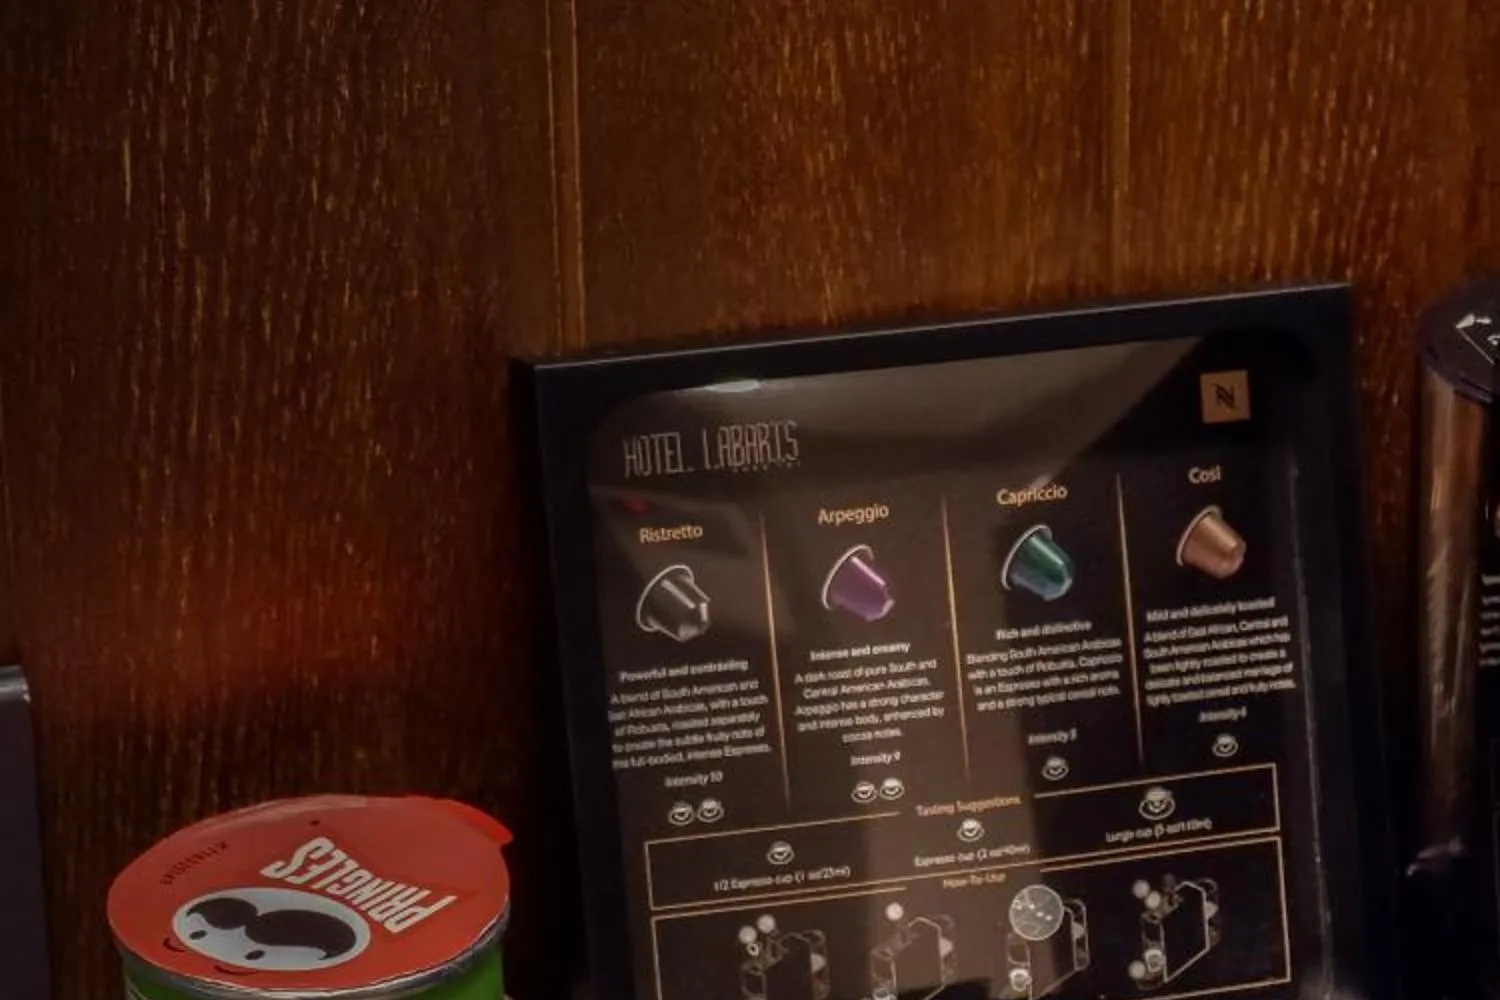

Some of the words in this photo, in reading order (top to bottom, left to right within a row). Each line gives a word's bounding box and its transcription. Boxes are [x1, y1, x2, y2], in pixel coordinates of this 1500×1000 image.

[623, 431, 695, 478] HOTEL
[703, 419, 800, 470] LABARIS
[996, 484, 1068, 507] Capriccio
[817, 504, 890, 526] Arpeggio
[639, 524, 703, 543] Ristretto
[259, 836, 457, 934] PRINGLES
